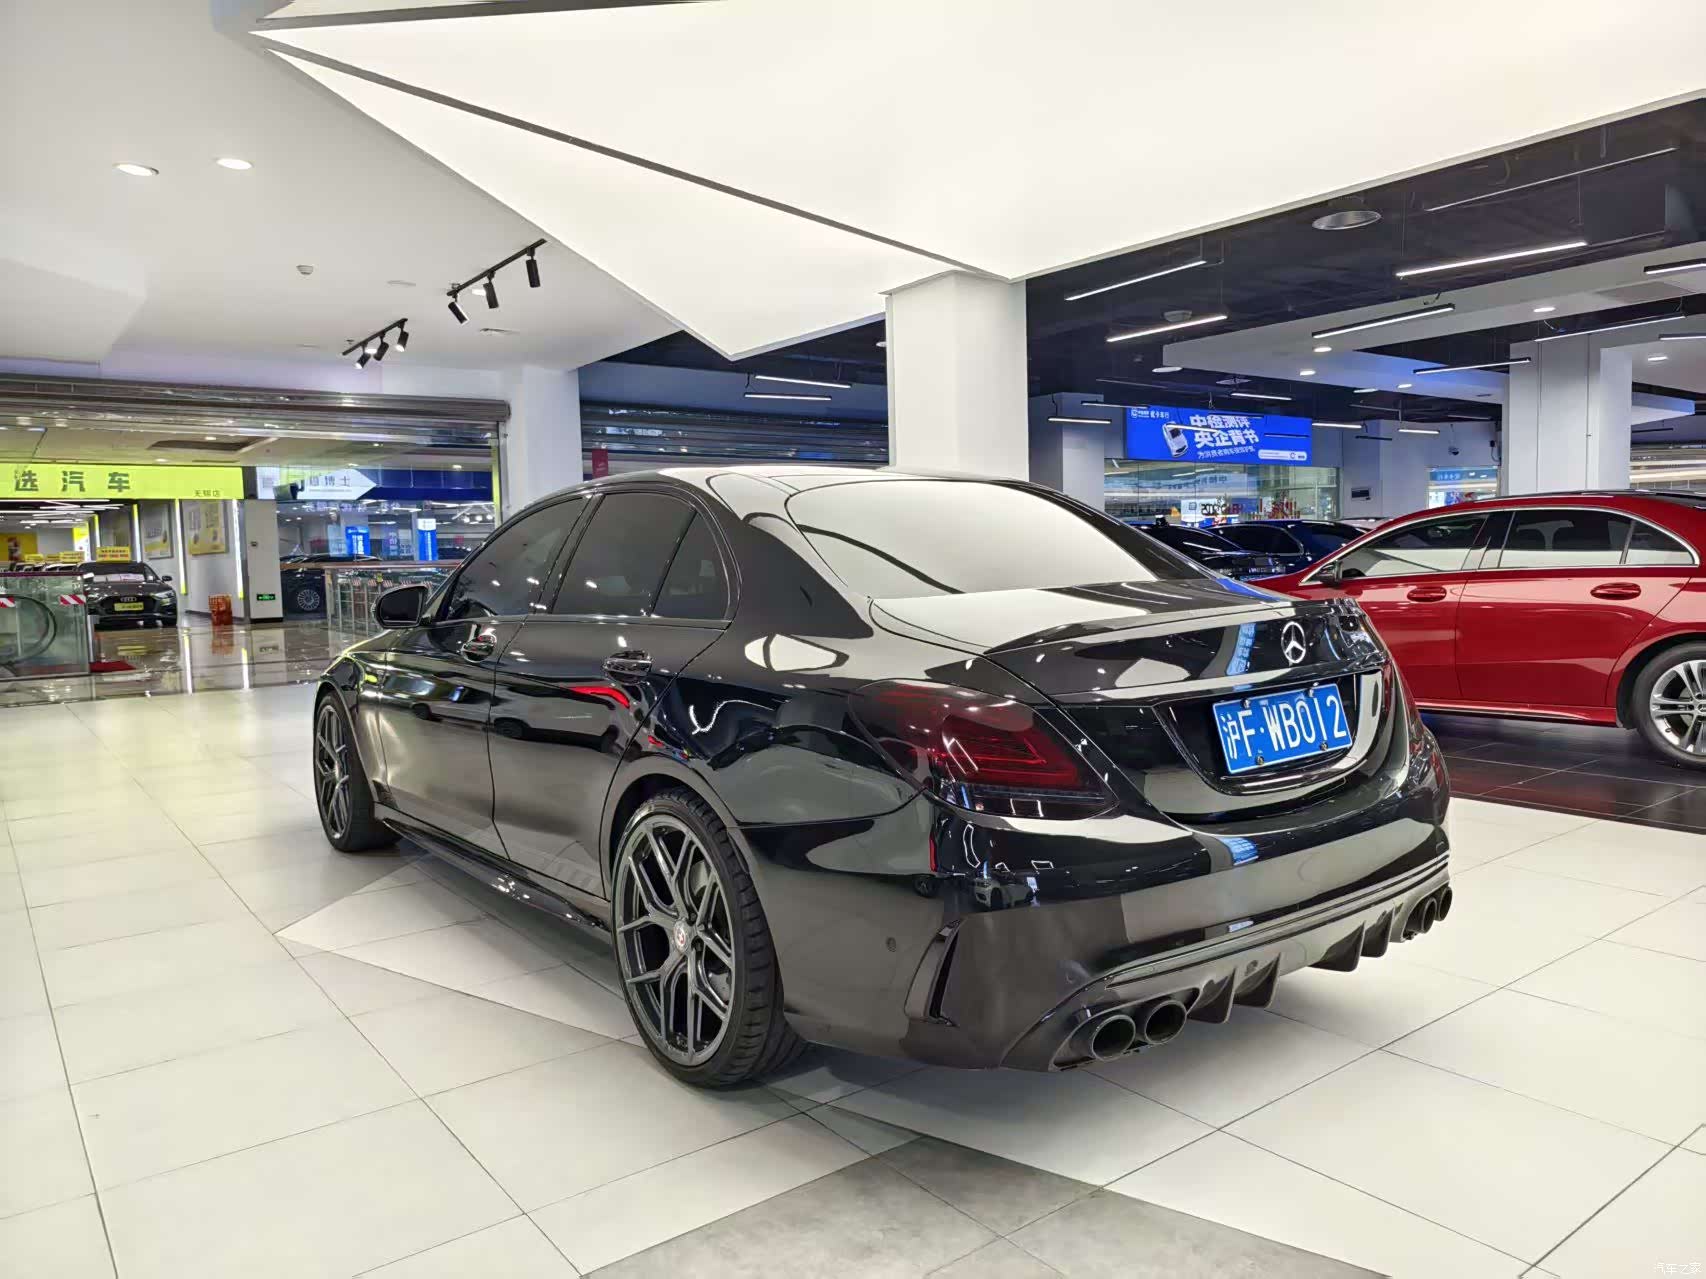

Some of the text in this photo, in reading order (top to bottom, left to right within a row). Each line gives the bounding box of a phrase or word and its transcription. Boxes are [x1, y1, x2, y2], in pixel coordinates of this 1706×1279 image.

[1189, 414, 1251, 429] 中检测评
[1194, 428, 1260, 448] 央企背书
[14, 470, 131, 493] 选汽车
